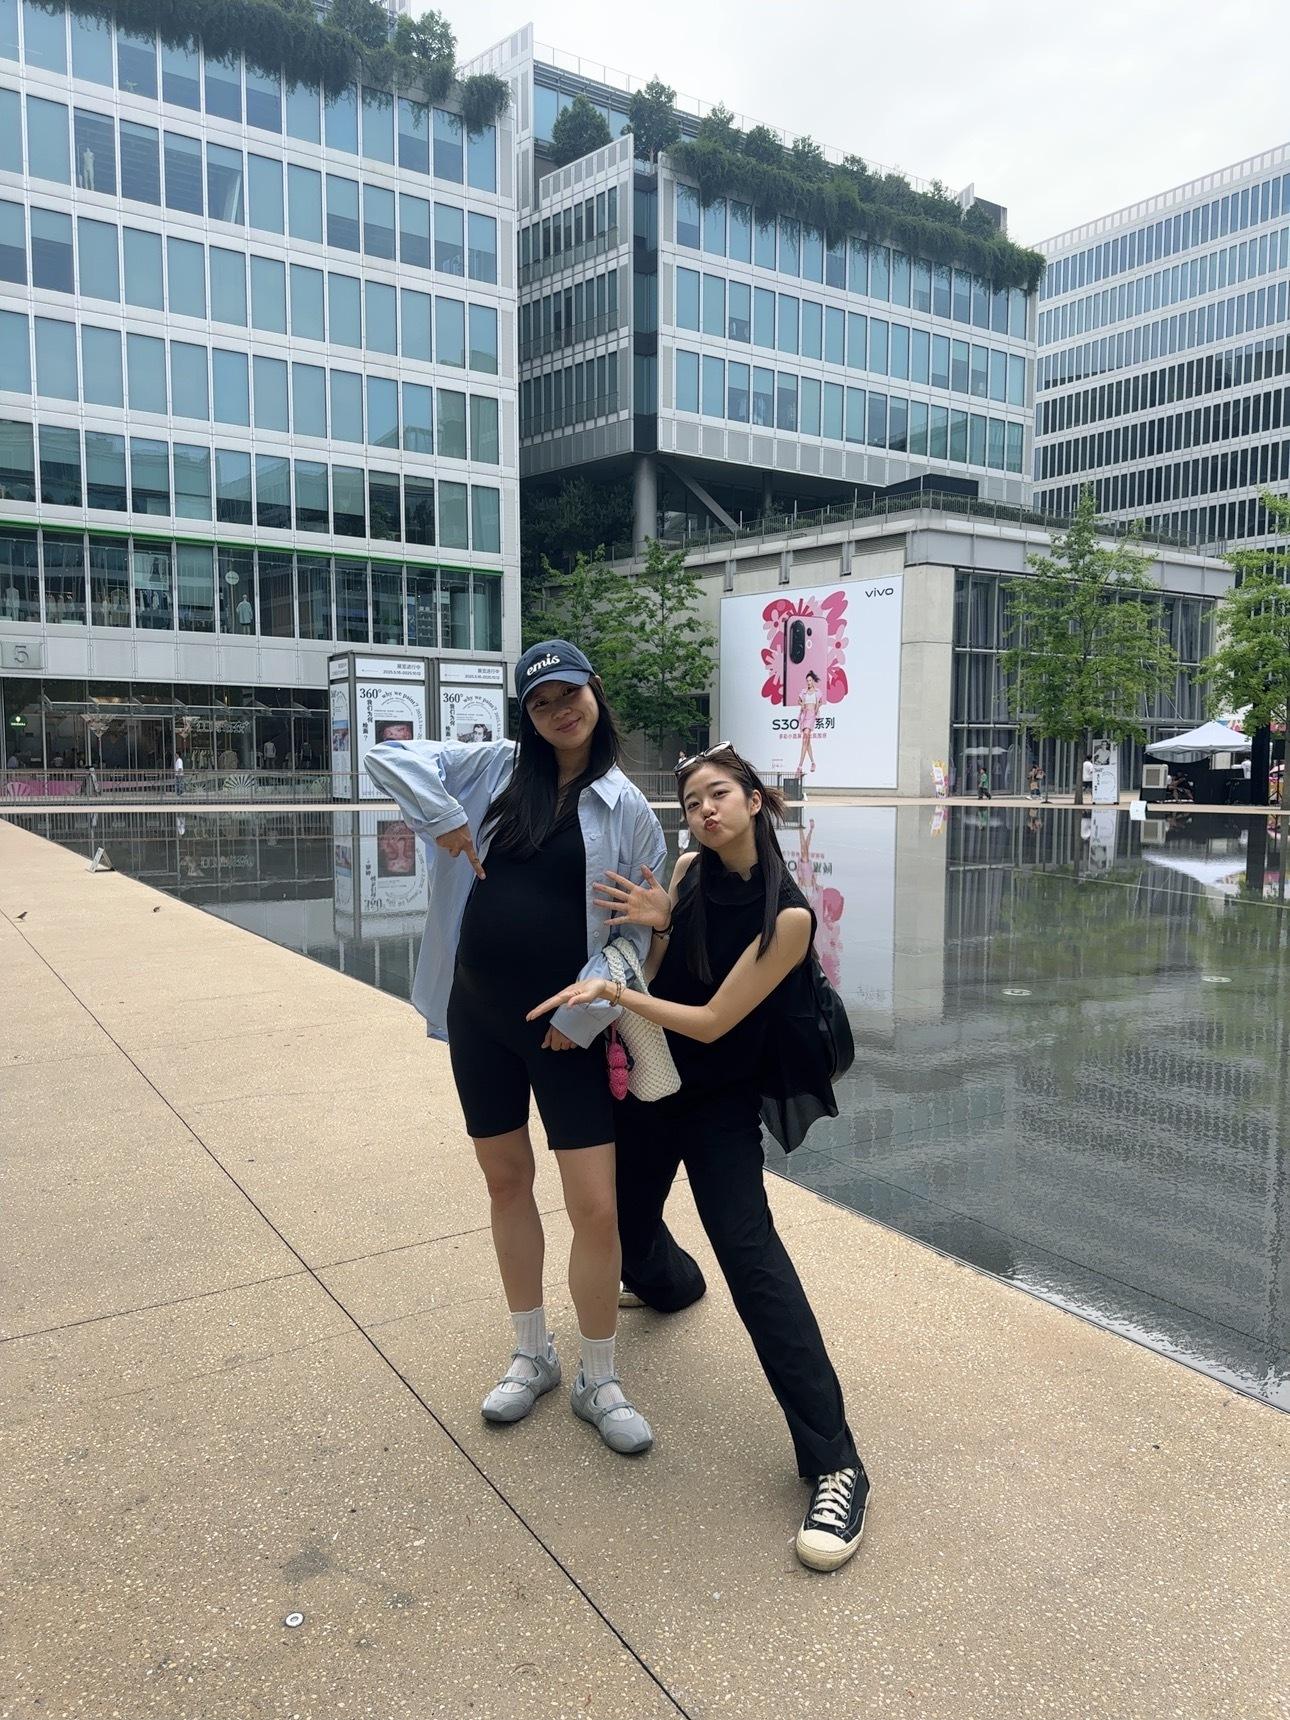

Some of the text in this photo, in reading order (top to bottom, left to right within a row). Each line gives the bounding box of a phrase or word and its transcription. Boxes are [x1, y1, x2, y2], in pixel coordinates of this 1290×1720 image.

[865, 587, 894, 598] vivo
[14, 645, 29, 663] 5
[526, 653, 561, 676] emis
[772, 719, 800, 730] S30
[815, 717, 835, 729] 系列
